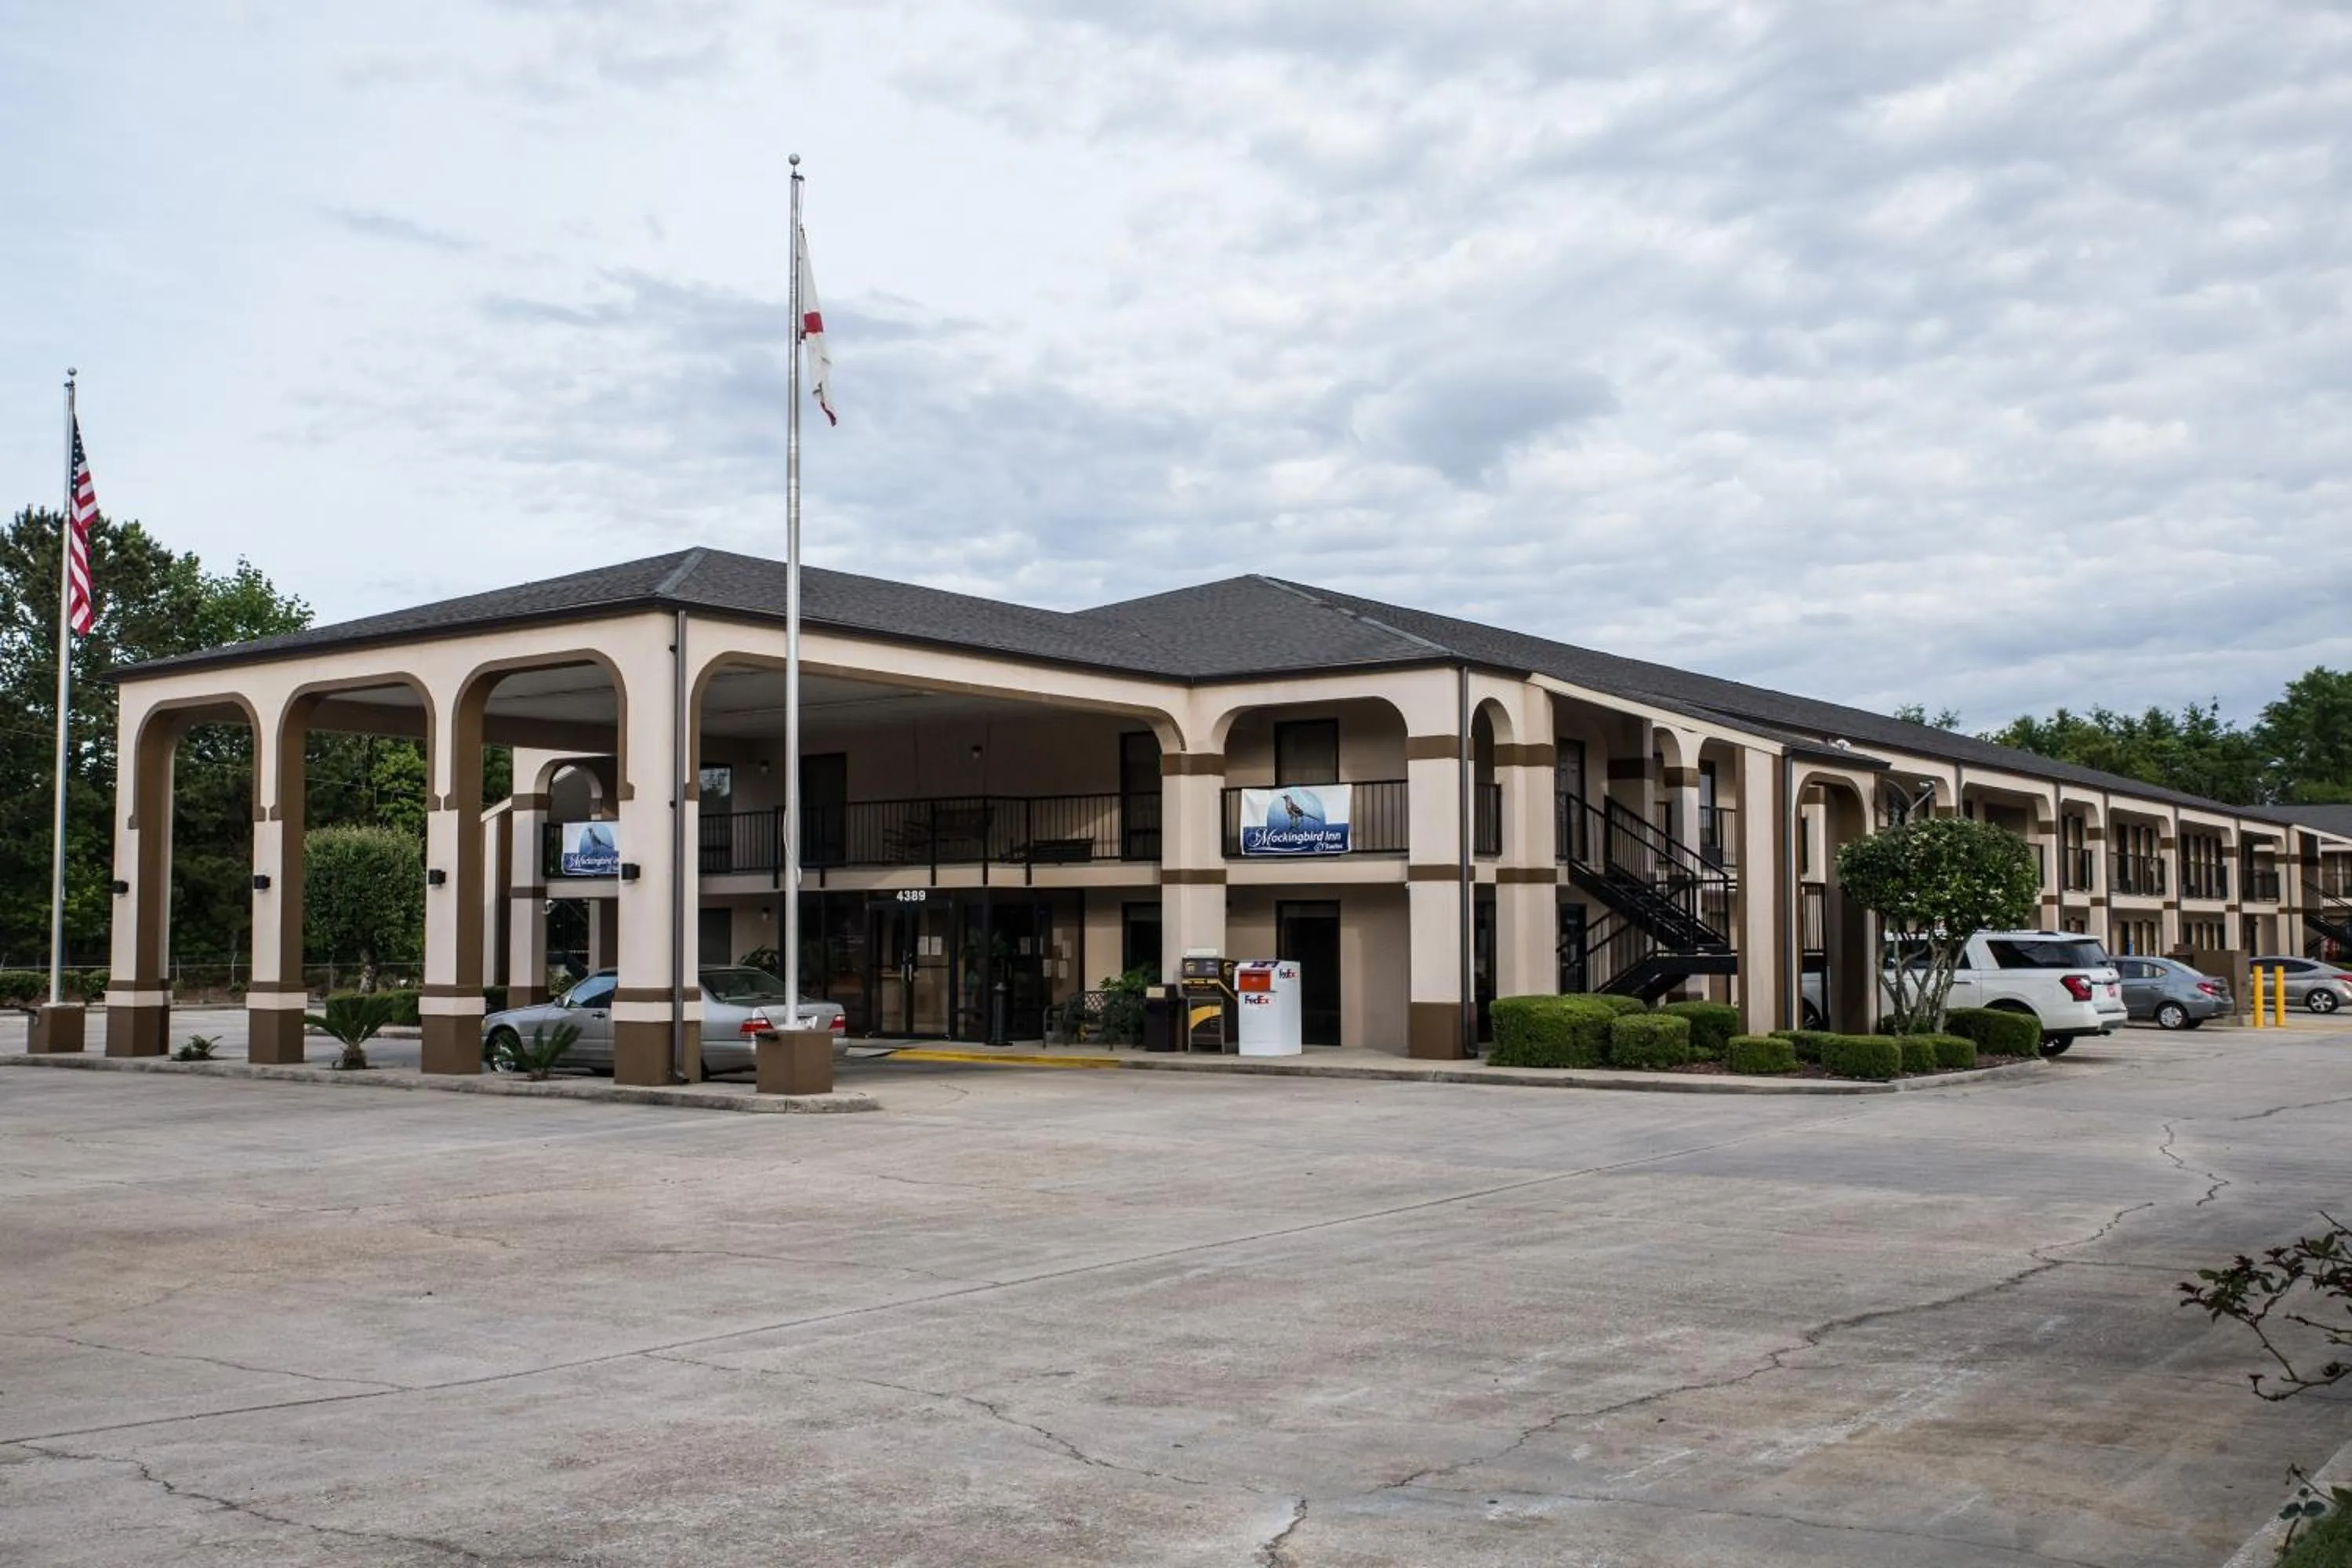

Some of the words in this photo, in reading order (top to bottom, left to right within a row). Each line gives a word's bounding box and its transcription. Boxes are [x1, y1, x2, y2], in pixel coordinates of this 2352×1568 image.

[1252, 828, 1324, 847] Mockingbird
[1324, 830, 1341, 841] Inn
[896, 890, 926, 901] 4389
[1244, 995, 1269, 1004] FedEx
